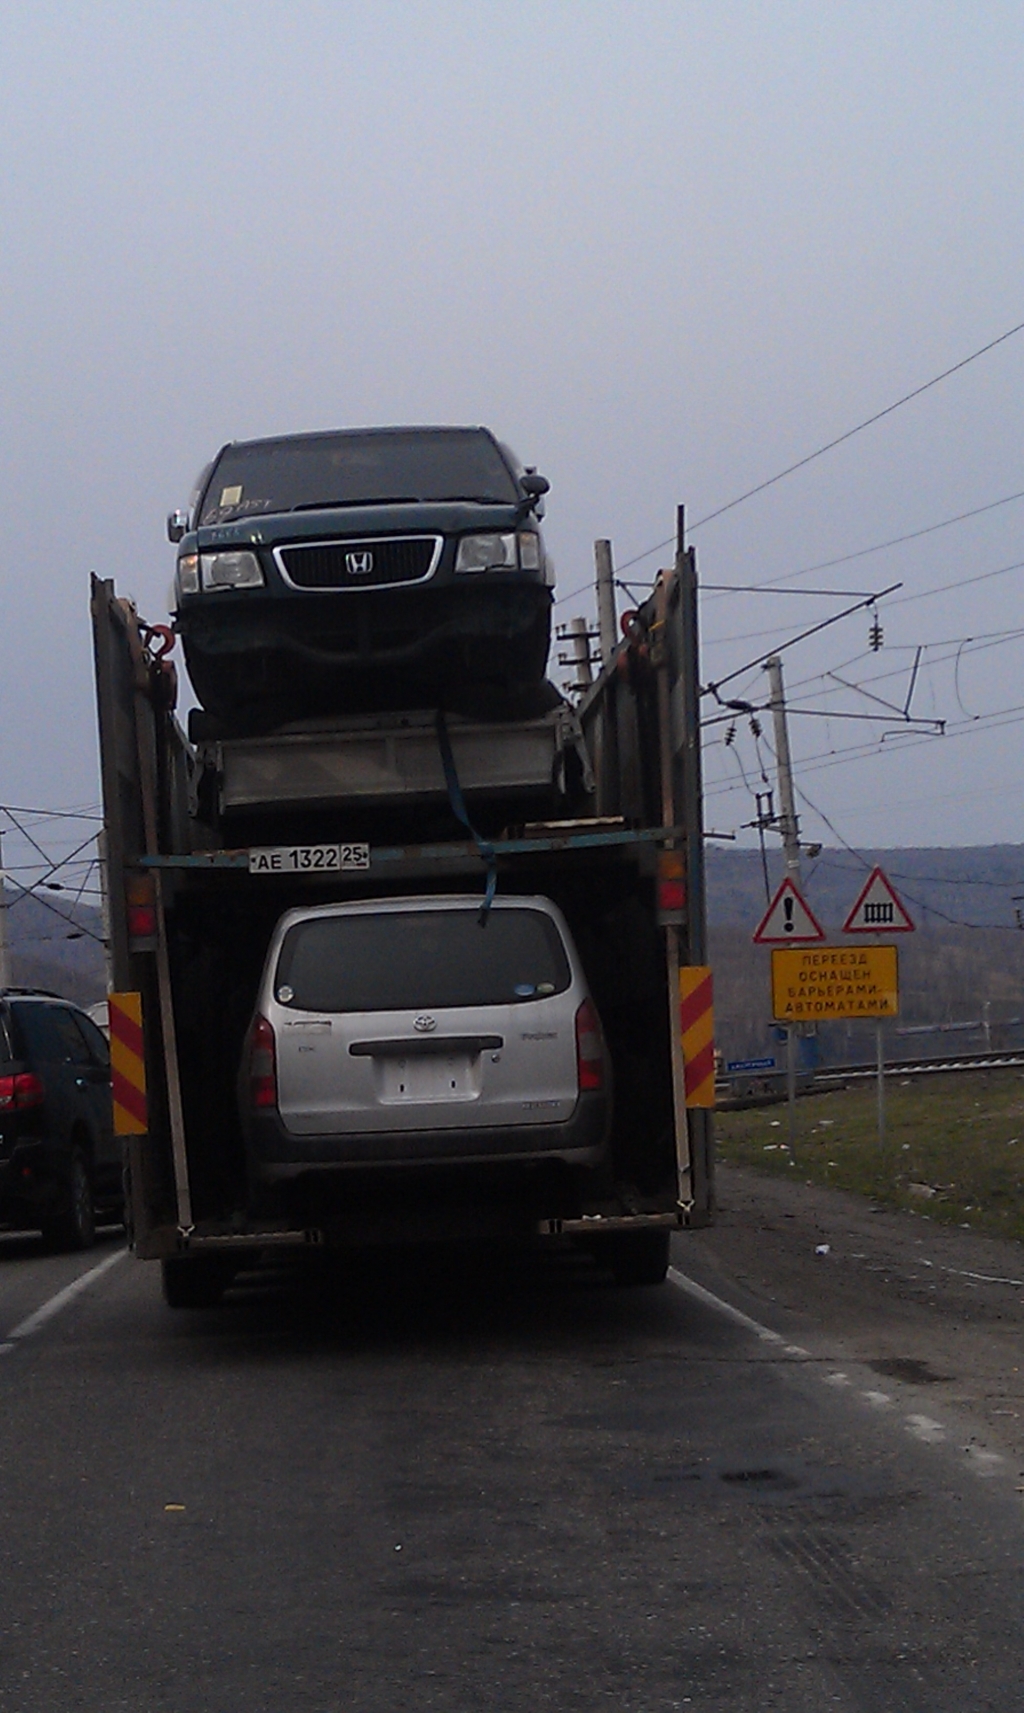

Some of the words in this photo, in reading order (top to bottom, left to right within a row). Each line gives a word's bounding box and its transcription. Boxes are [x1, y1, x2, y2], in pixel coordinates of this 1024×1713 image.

[288, 848, 338, 869] 1322
[343, 846, 362, 862] 25
[802, 953, 867, 966] ПЕРЕЕЗД
[798, 969, 871, 982] ОСНАЩЕН
[785, 998, 889, 1013] АВТОМАТАМИ
